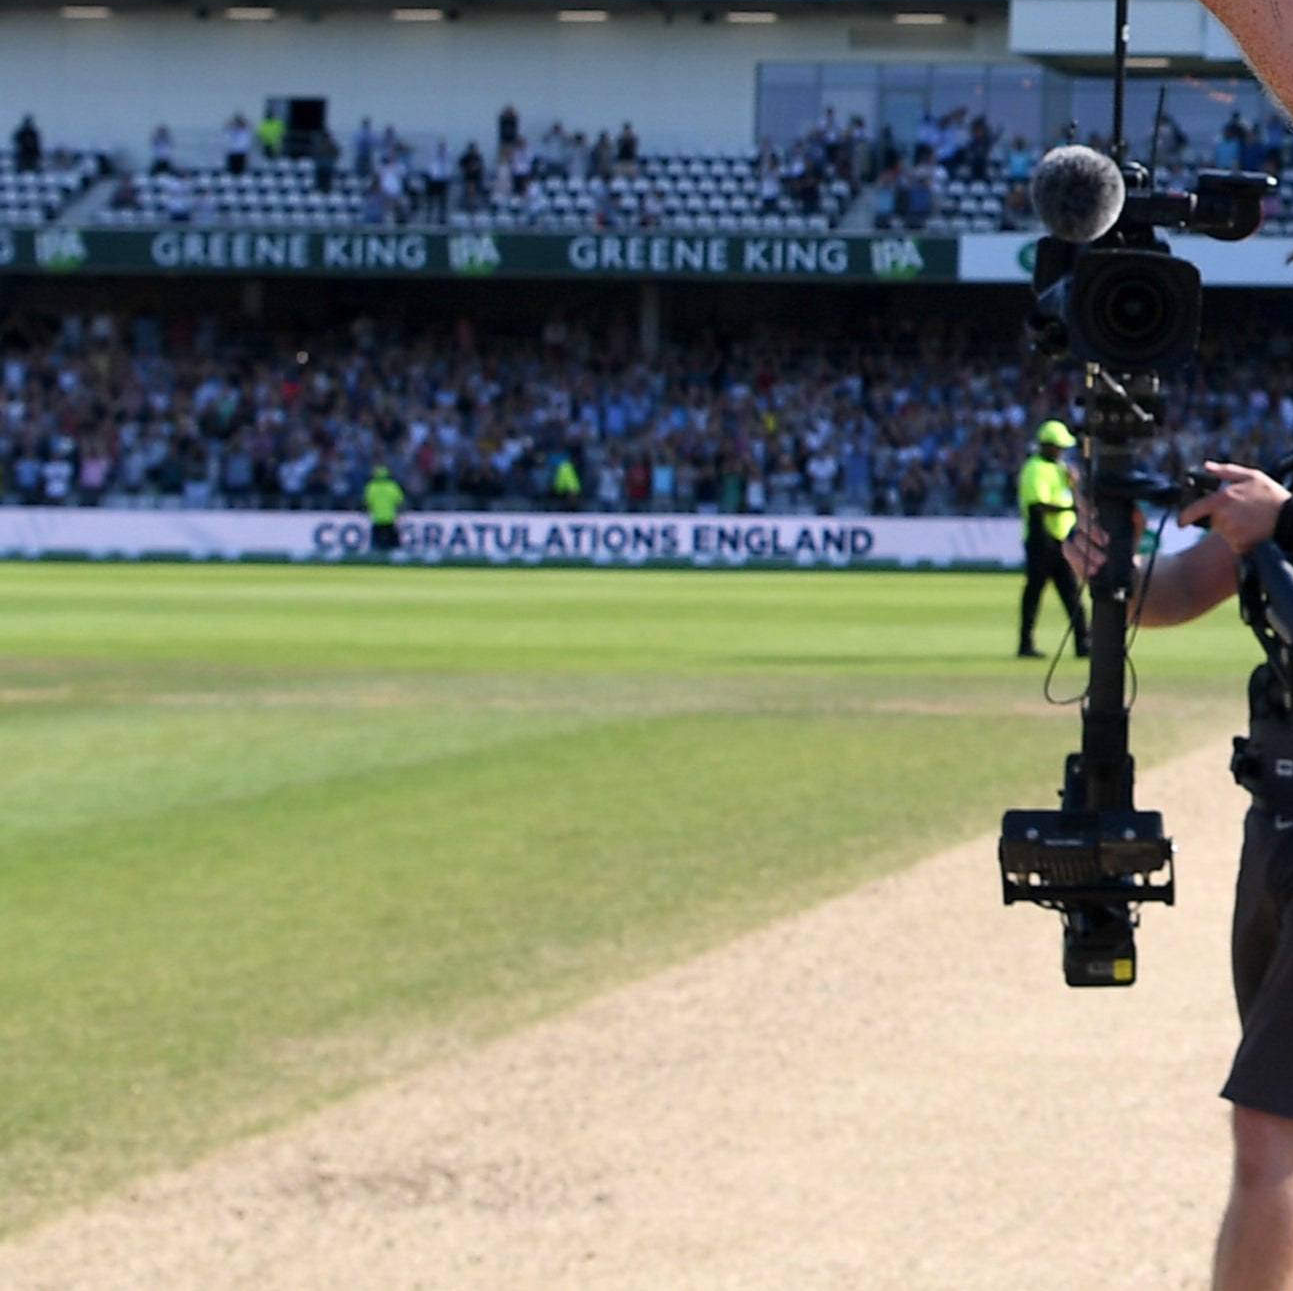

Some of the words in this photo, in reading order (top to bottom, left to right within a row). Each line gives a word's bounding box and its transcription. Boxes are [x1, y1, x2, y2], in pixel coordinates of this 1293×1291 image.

[151, 231, 310, 269] GREENE
[323, 233, 426, 270] KING
[568, 236, 728, 272] GREENE
[743, 238, 848, 274] KING
[313, 521, 680, 555] COGRATULATIONS
[693, 524, 875, 556] ENGLAND
